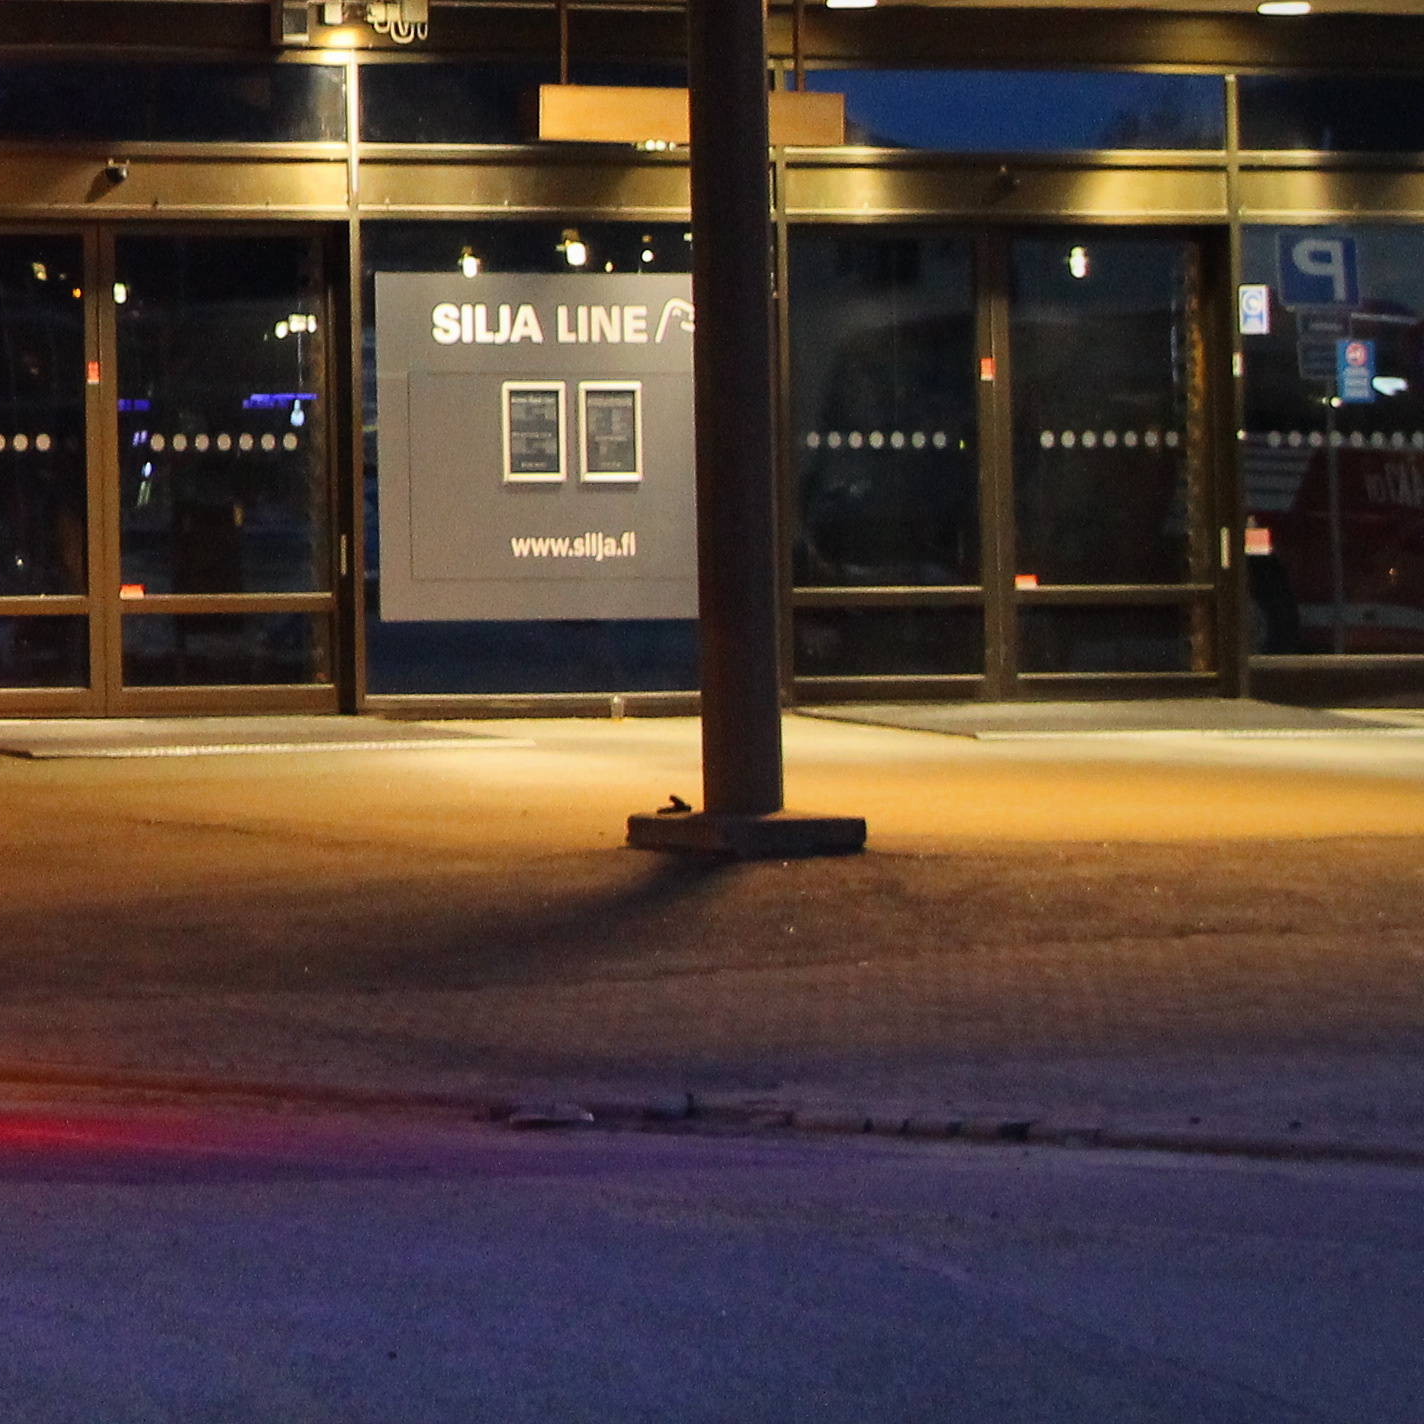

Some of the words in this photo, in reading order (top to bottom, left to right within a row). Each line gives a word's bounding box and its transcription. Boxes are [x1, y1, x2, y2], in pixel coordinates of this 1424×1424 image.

[431, 302, 544, 345] SILJA
[556, 304, 649, 344] LINE
[510, 531, 637, 562] www.silja.fi
